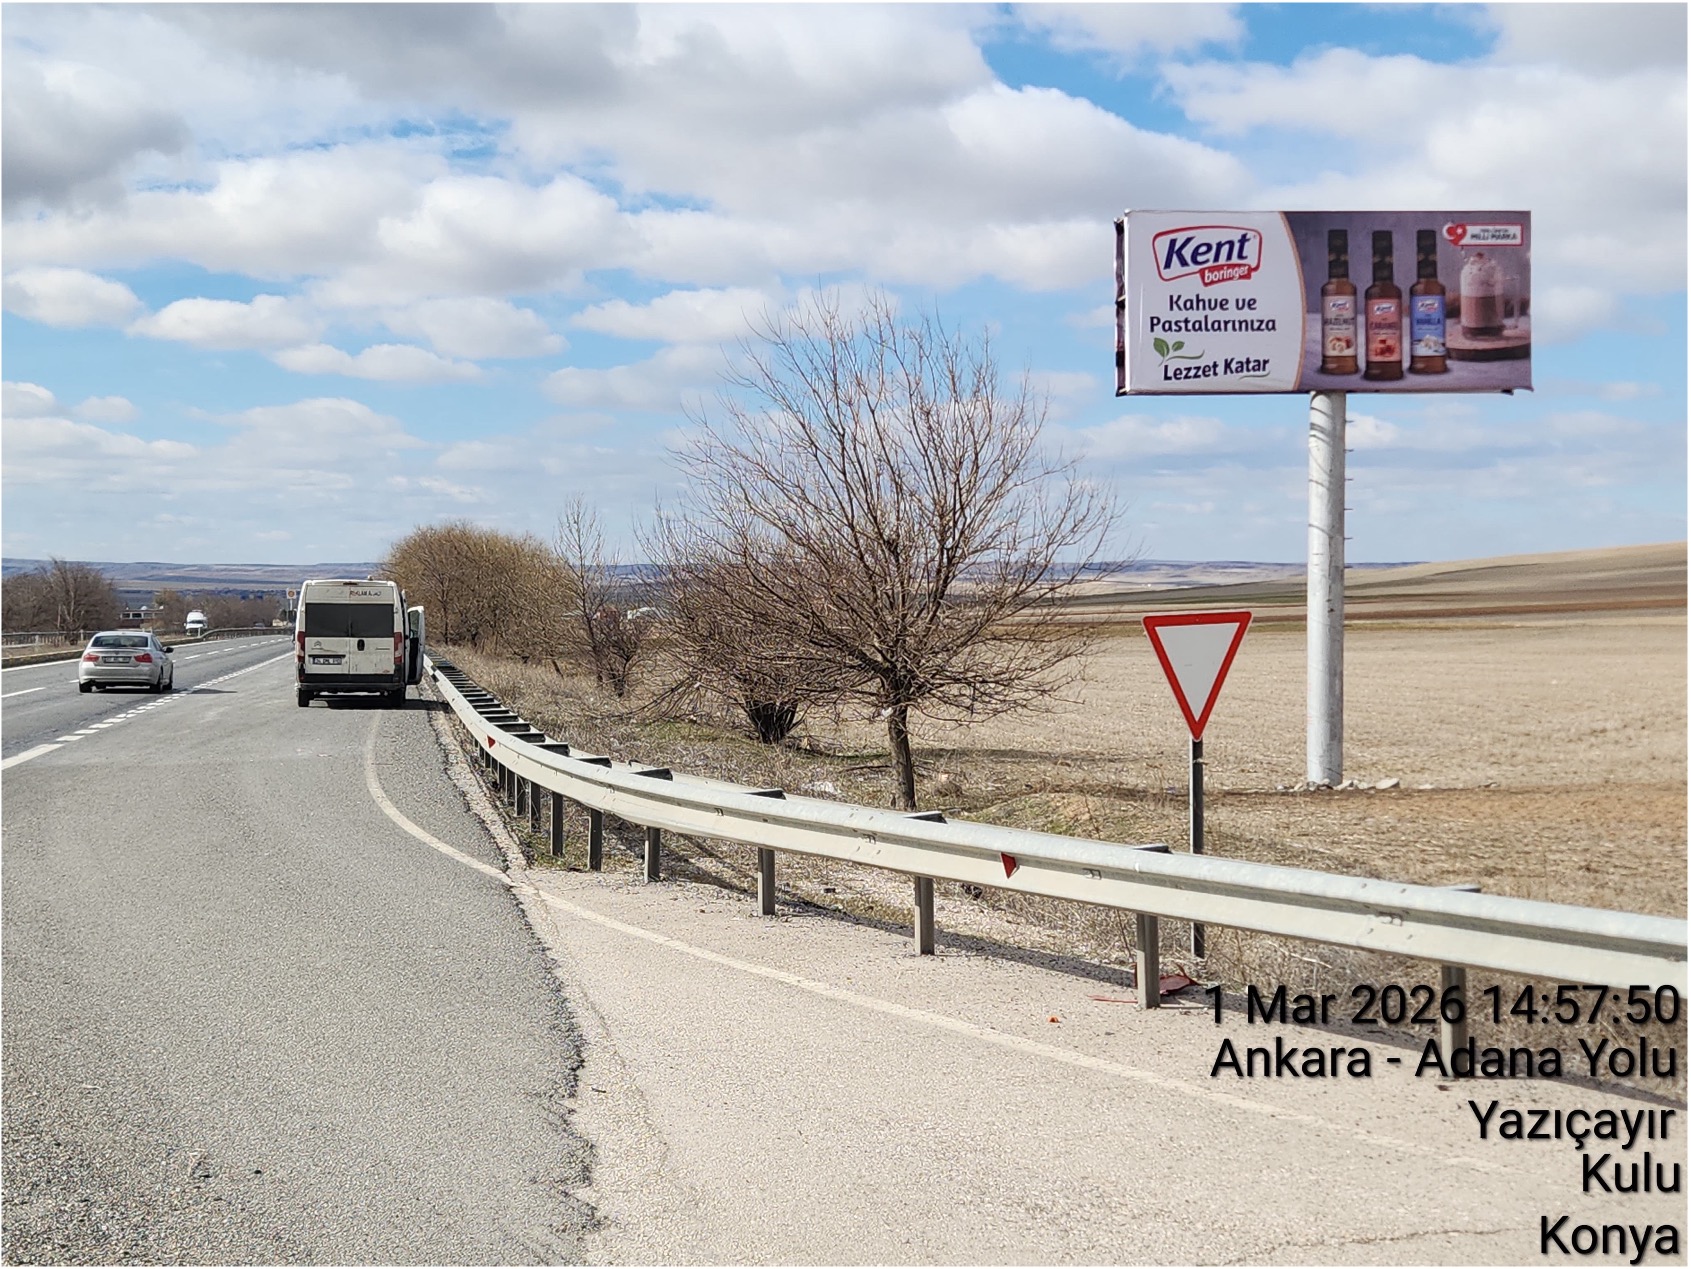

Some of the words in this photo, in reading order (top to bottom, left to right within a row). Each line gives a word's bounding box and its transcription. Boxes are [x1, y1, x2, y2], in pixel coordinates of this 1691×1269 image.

[1163, 232, 1251, 270] Kent
[1204, 265, 1249, 284] boringer
[1169, 293, 1229, 311] Kahve
[1235, 297, 1257, 311] ve
[1149, 314, 1277, 333] Pastalarınıza
[1163, 361, 1219, 381] Lezzet
[1223, 357, 1270, 375] Katar
